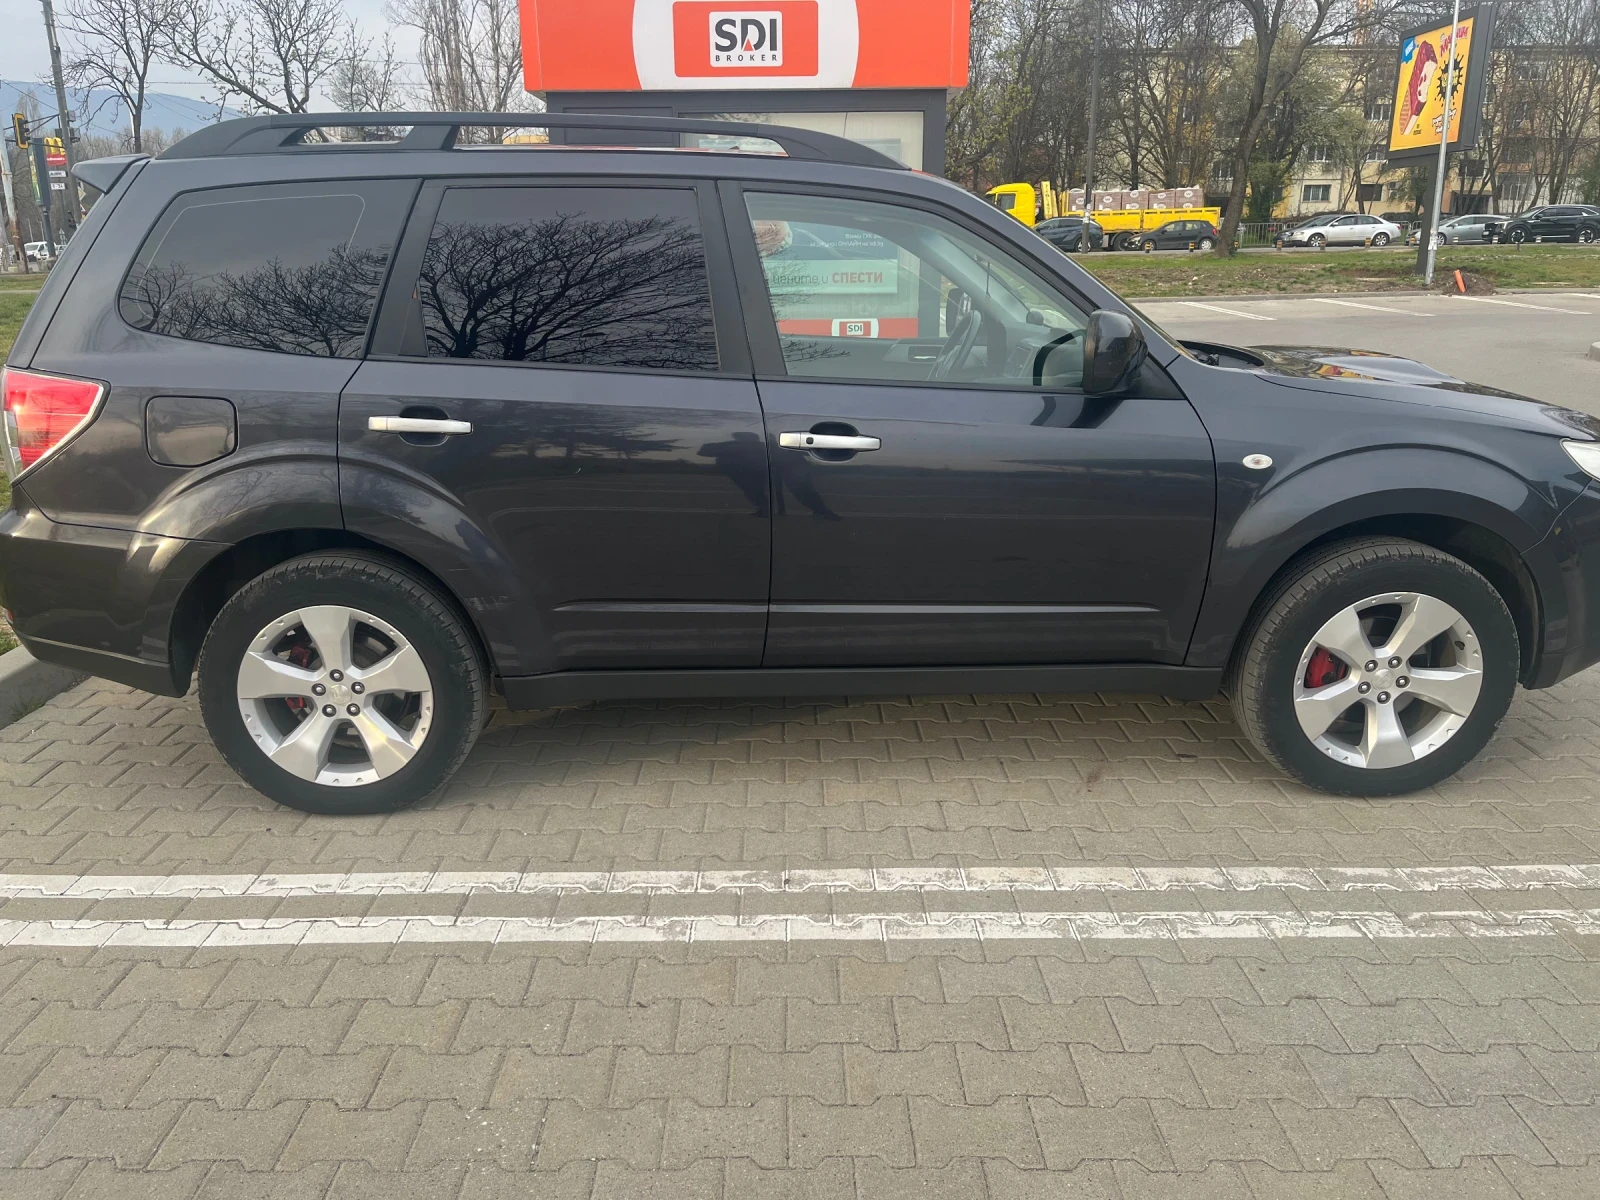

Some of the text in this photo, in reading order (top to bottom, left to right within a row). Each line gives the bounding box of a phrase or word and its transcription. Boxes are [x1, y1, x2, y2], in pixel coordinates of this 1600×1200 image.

[714, 18, 778, 52] SDI
[715, 54, 778, 62] BROKER
[832, 272, 883, 284] СПЕСТИ
[848, 324, 862, 332] SDI
